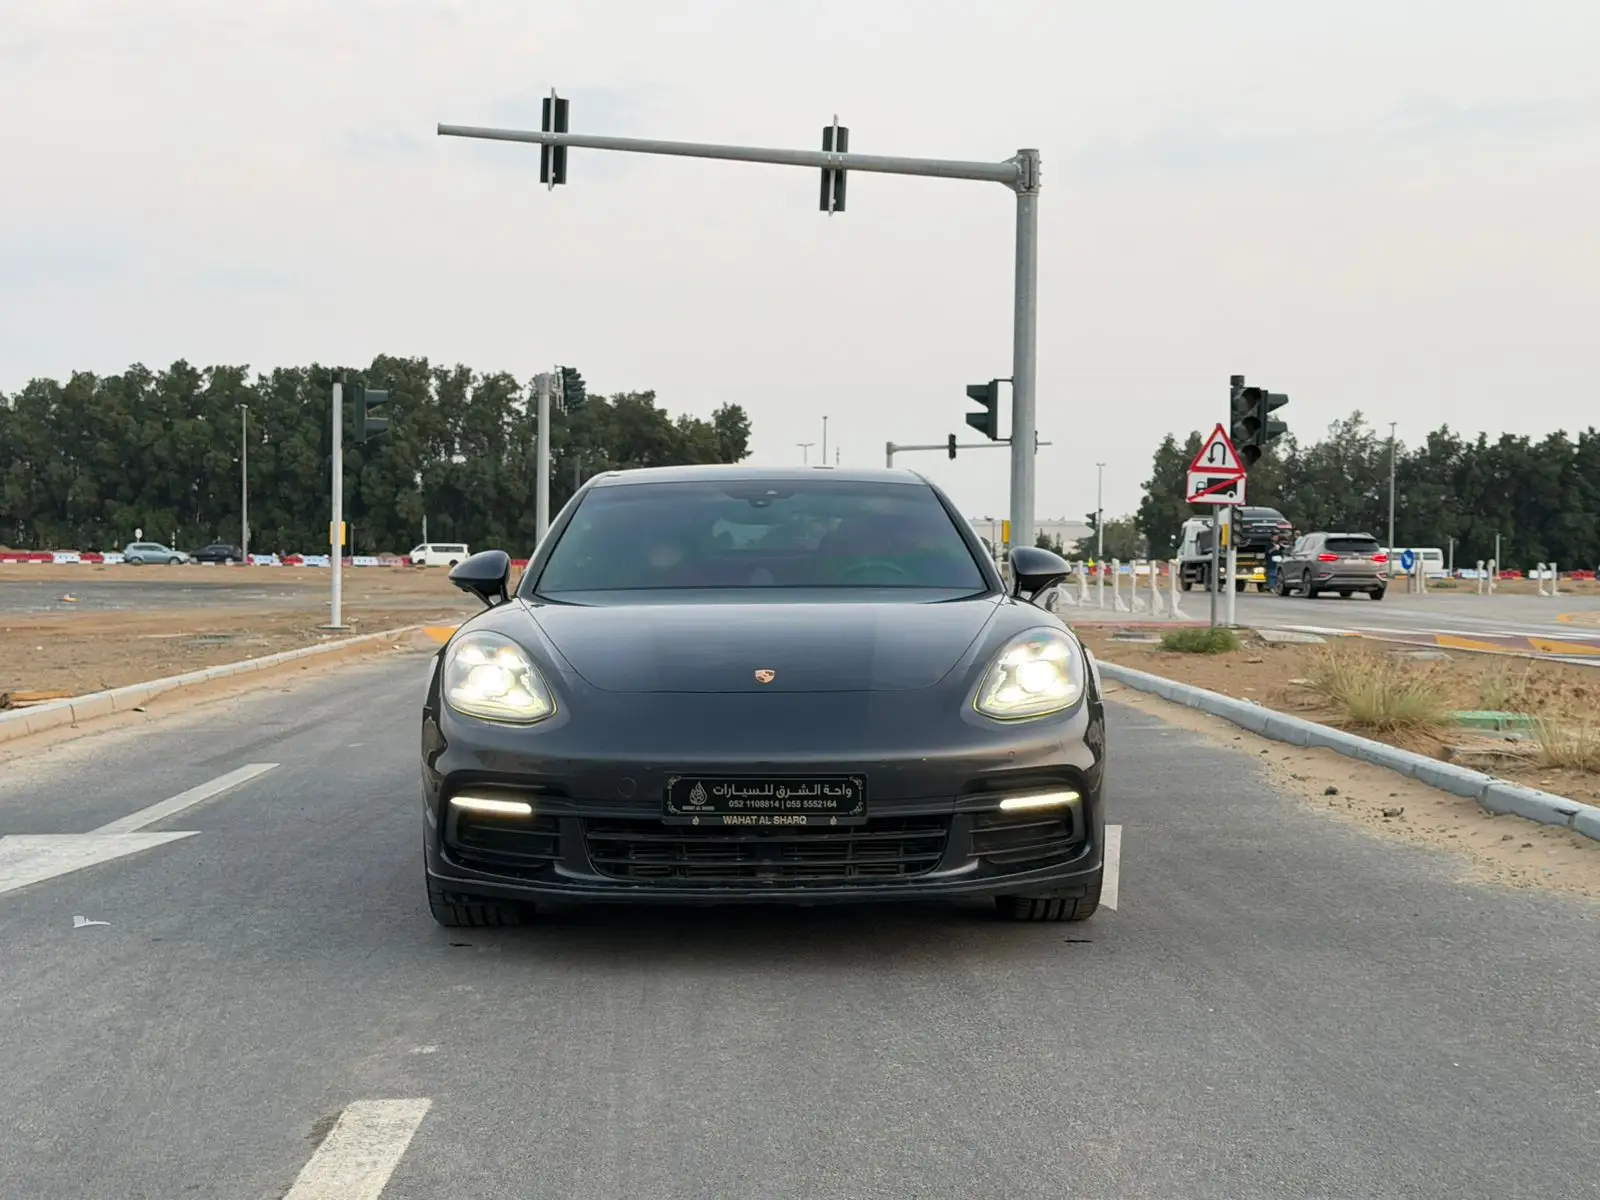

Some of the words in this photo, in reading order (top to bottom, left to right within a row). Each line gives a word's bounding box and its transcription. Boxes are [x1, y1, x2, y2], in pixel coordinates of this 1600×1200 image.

[713, 784, 773, 798] للسيارات
[776, 784, 821, 798] الشرق
[823, 784, 852, 798] واحة
[728, 800, 744, 808] 052
[786, 800, 801, 808] 055
[722, 815, 757, 825] WAHAT
[759, 815, 772, 825] AL
[773, 815, 807, 825] SHARQ
